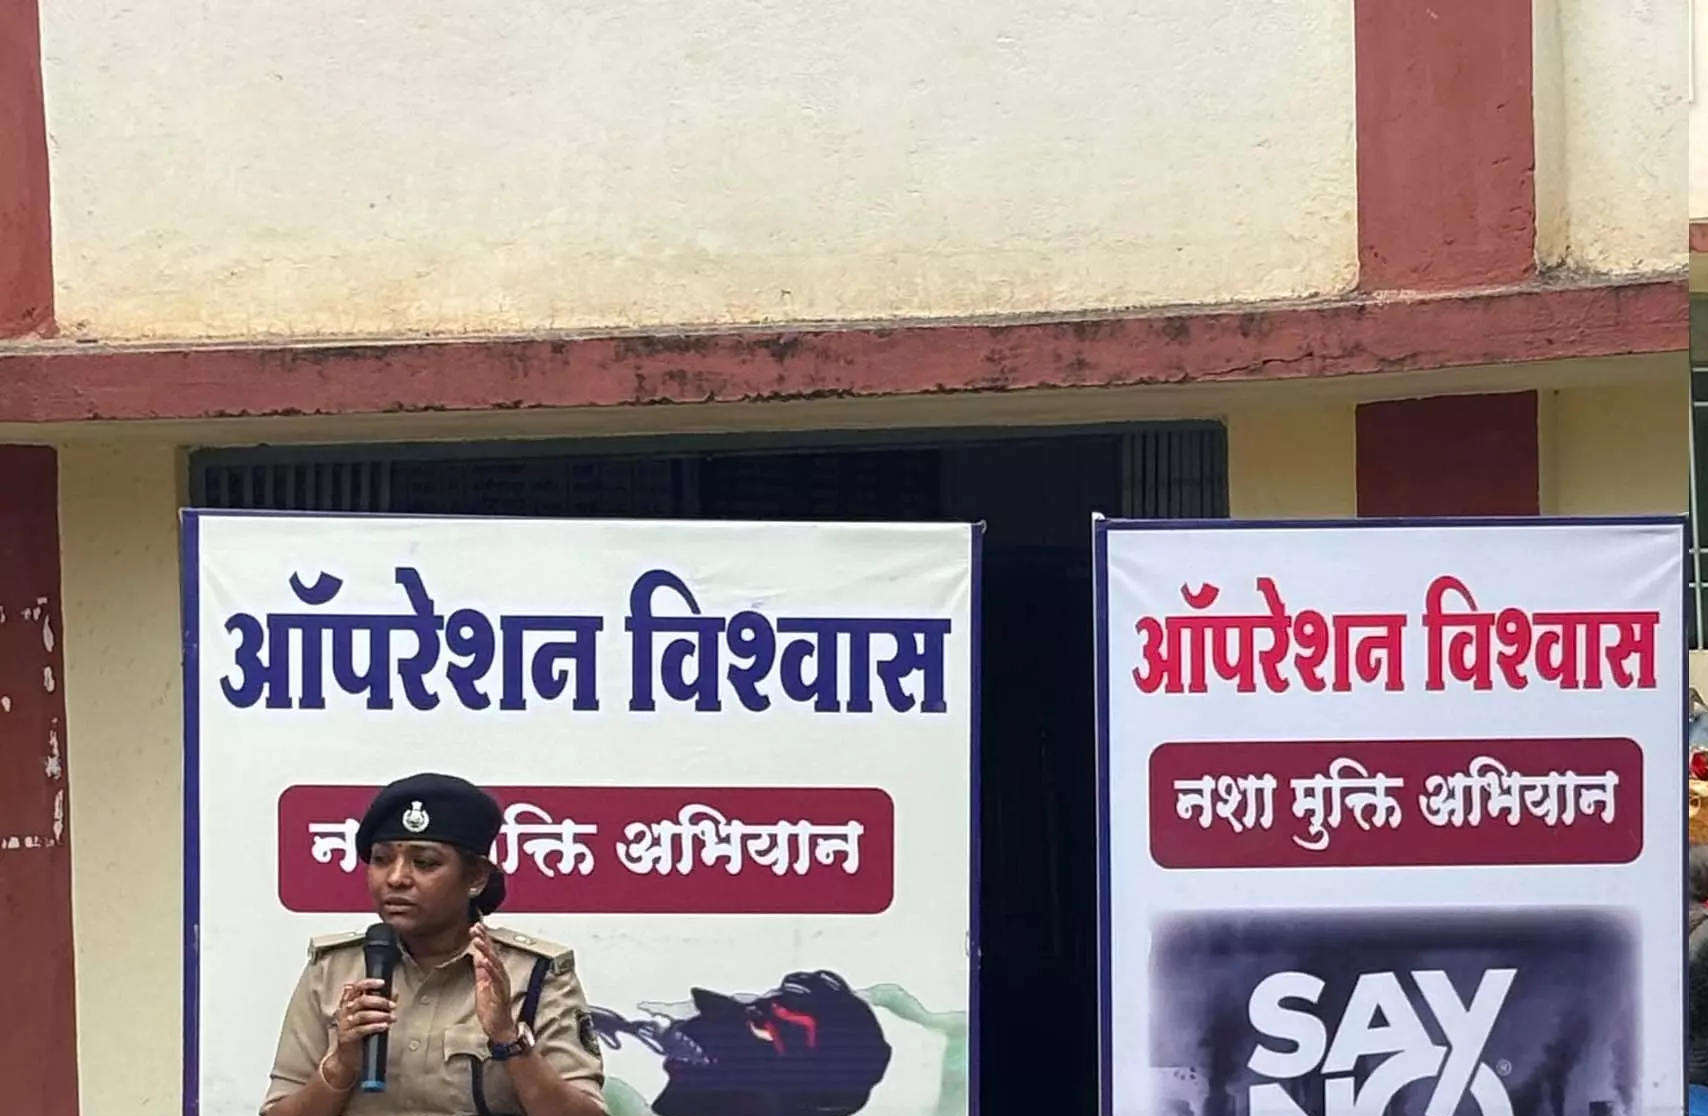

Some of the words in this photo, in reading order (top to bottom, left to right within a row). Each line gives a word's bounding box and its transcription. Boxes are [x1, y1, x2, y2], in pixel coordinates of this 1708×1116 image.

[219, 566, 603, 712] ऑपरेशन
[625, 568, 952, 713] विश्वास
[1131, 576, 1407, 694] ऑपरेशन
[1422, 575, 1660, 691] विश्वास
[615, 803, 865, 877] अभियान
[1173, 773, 1277, 833] नशा
[1290, 757, 1403, 850] मुक्ति
[1419, 755, 1619, 828] अभियान
